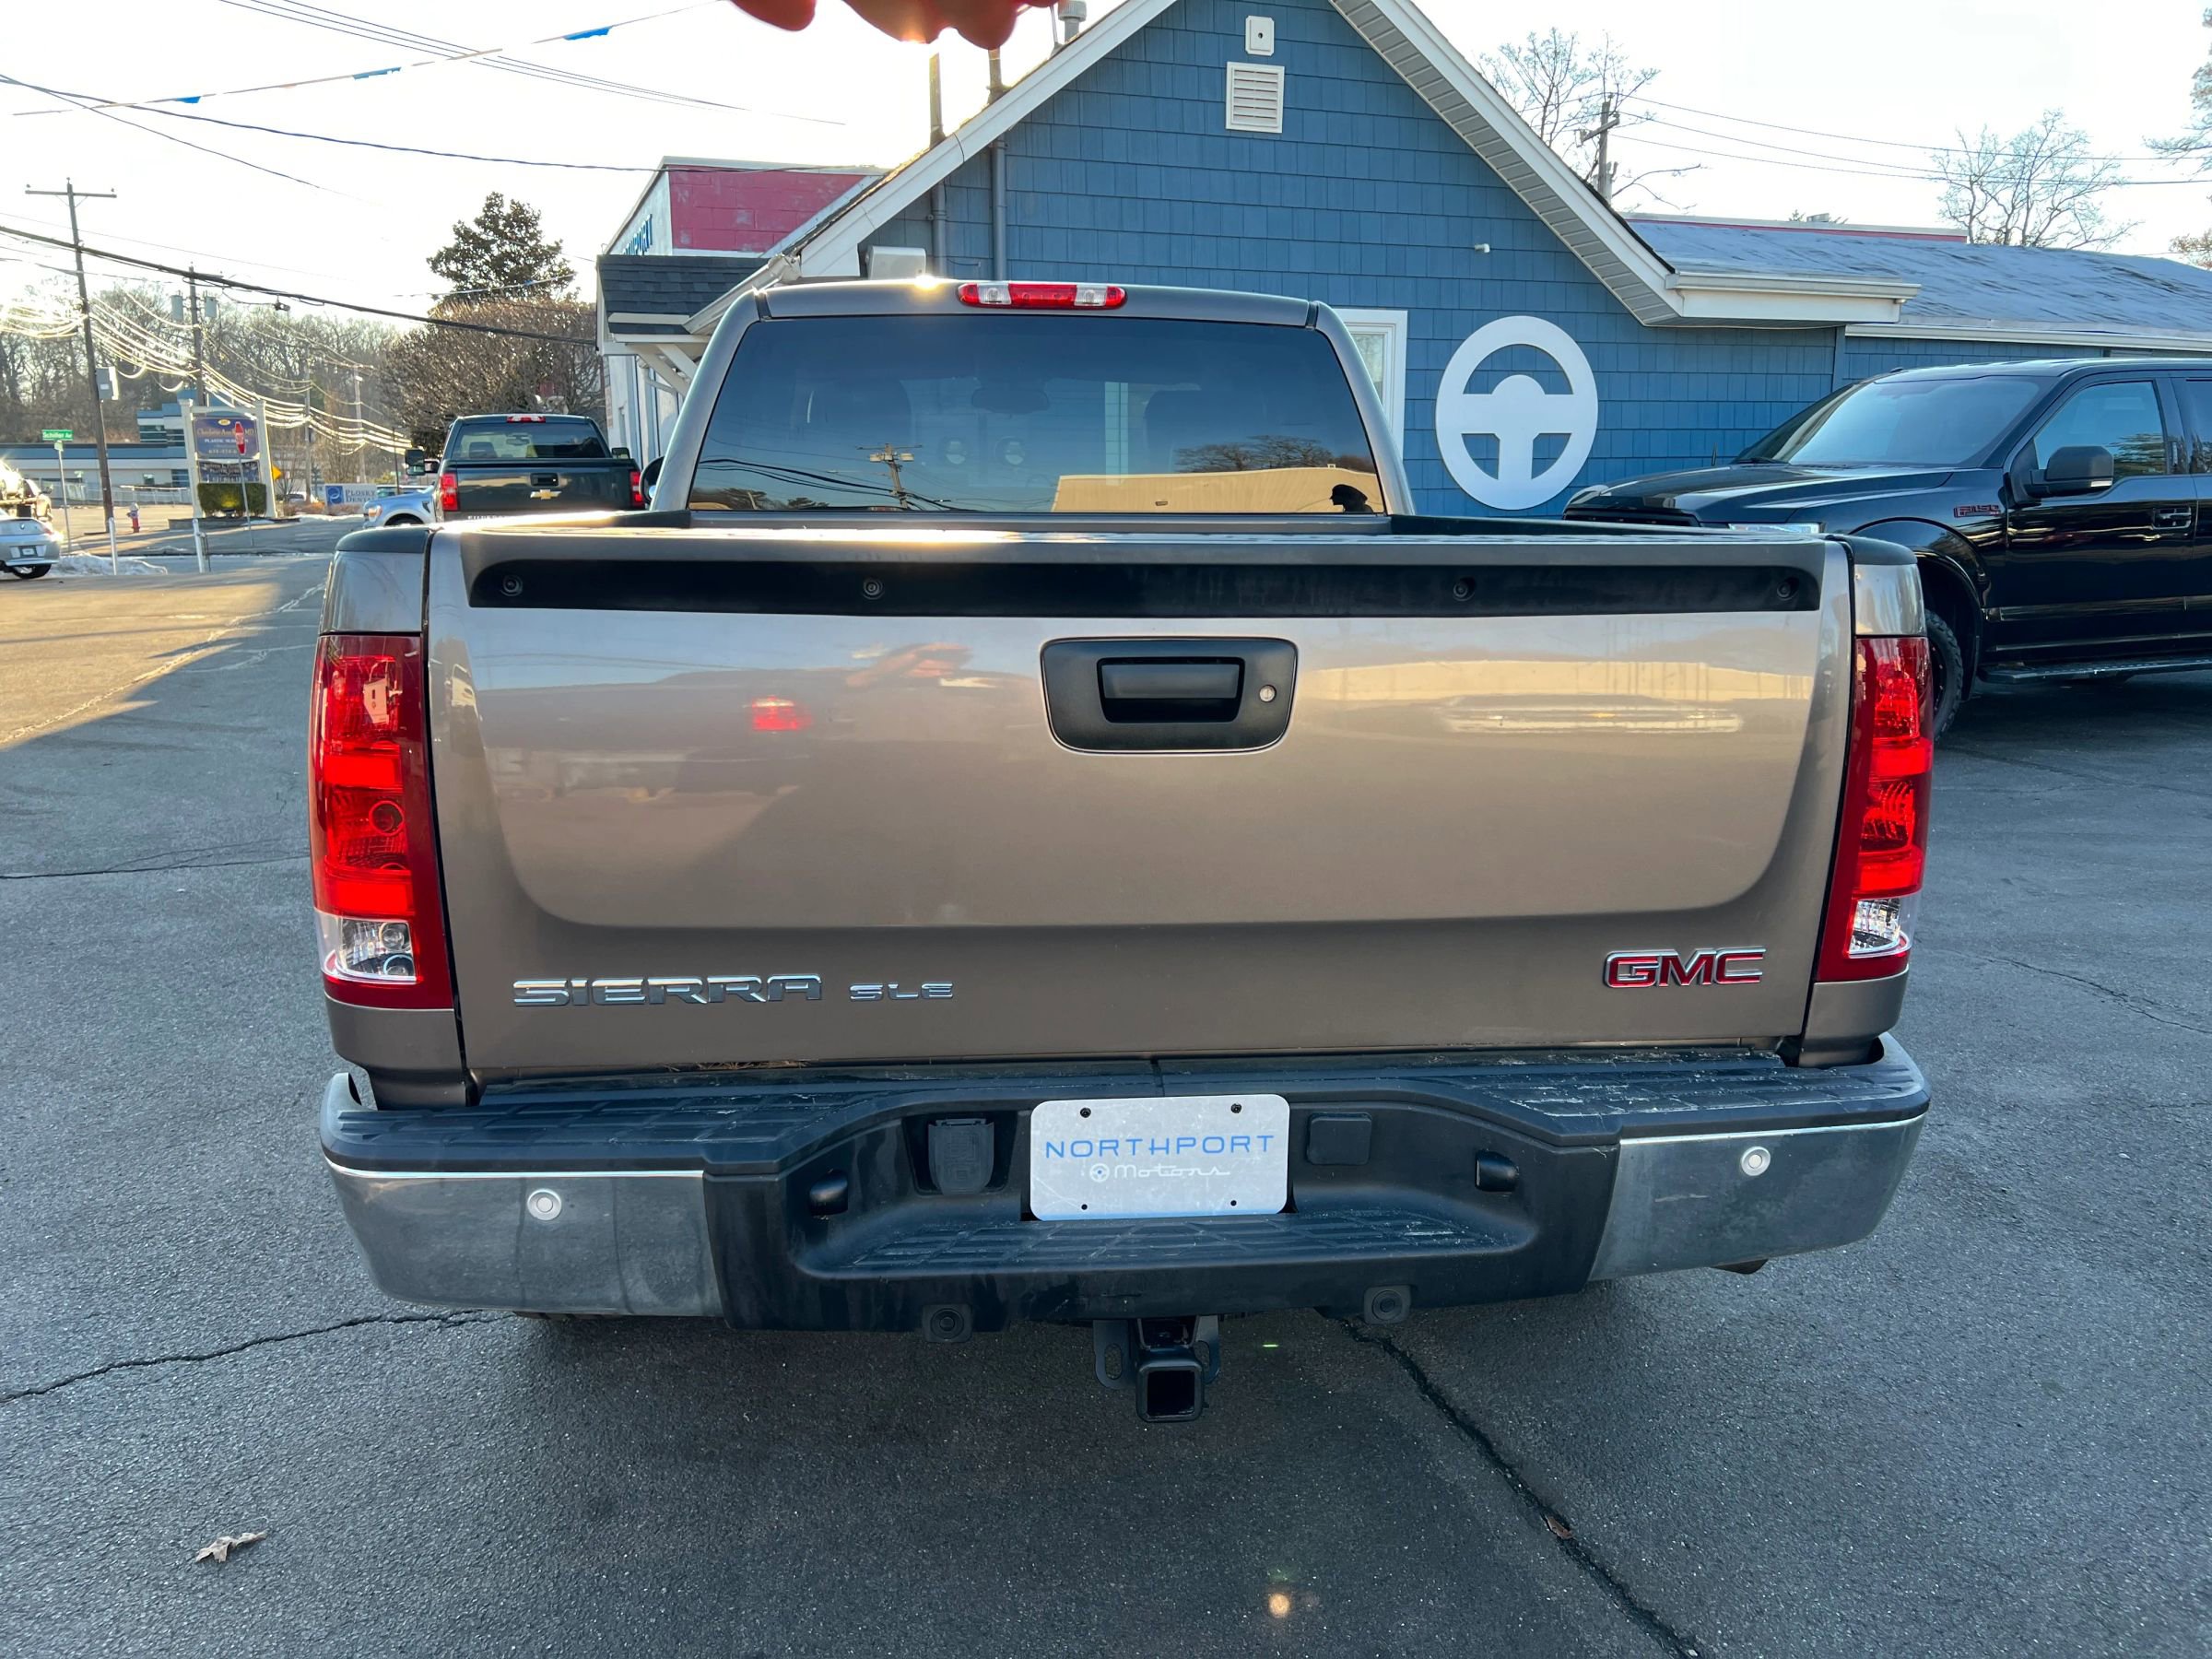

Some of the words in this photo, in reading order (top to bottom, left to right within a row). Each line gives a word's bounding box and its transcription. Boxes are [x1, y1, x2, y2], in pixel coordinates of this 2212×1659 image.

[1604, 946, 1767, 988] GMC
[512, 973, 823, 1006] SIERRA
[848, 982, 955, 1002] SLE
[1045, 1135, 1275, 1159] NORTHPORT
[1113, 1163, 1231, 1181] Motors
